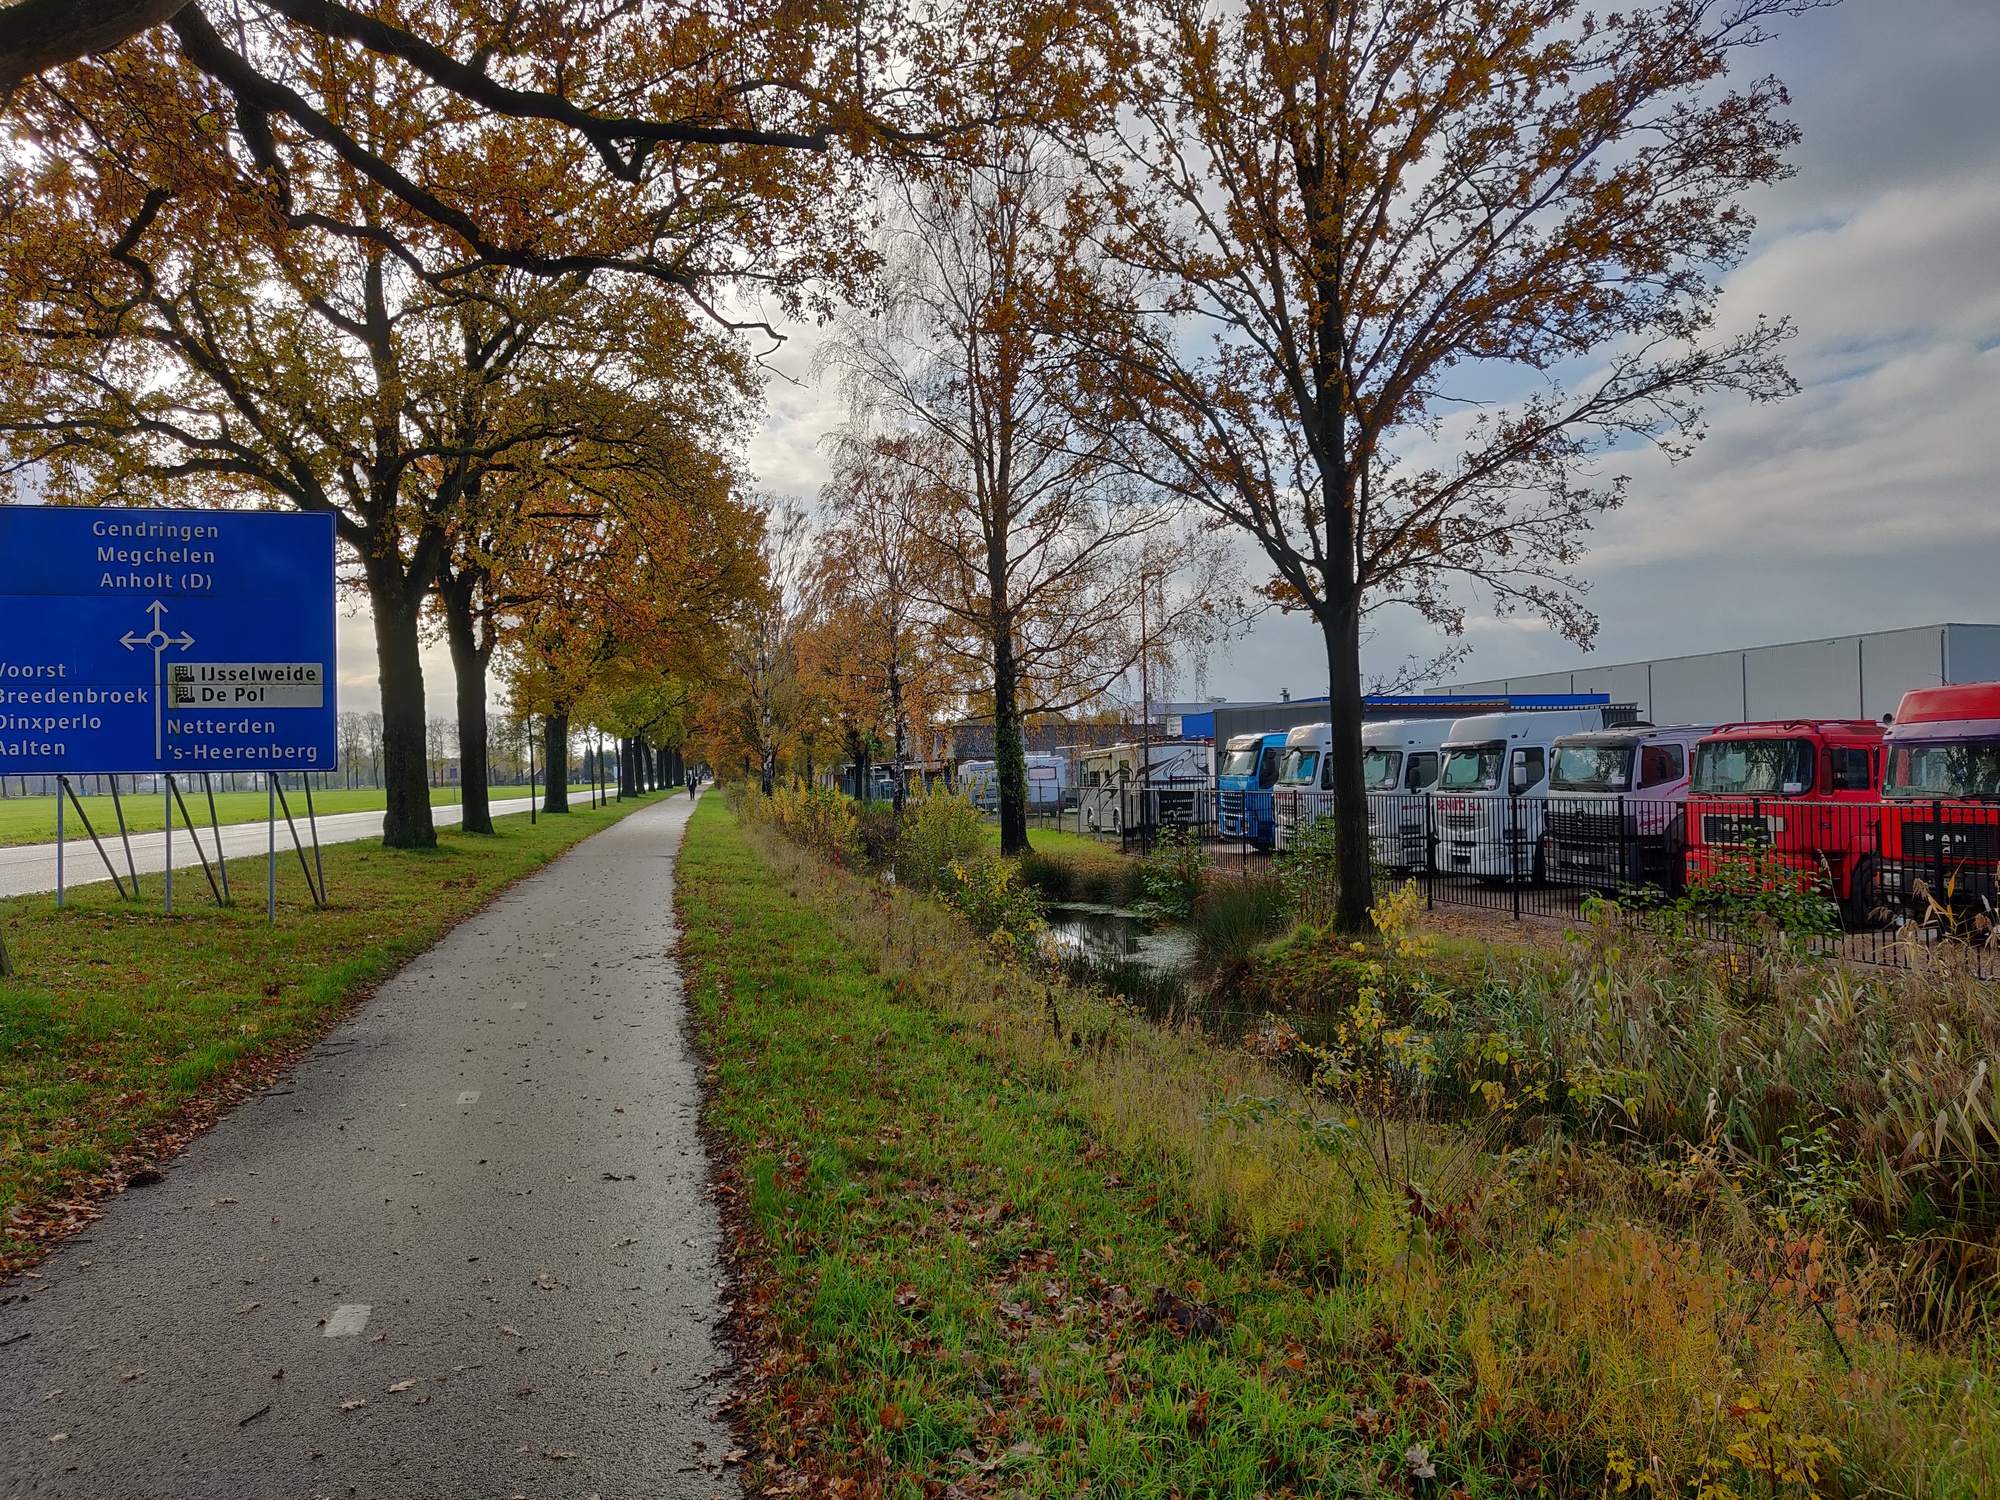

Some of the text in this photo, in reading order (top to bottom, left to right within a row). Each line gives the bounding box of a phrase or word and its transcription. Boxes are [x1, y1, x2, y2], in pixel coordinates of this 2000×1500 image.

[92, 521, 218, 542] Gendringen
[97, 546, 215, 566] Megchelen
[100, 572, 212, 590] Anholt (D)
[201, 665, 316, 681] IJsselweide
[202, 687, 265, 702] De Pol
[0, 713, 102, 734] Dinxperlo
[167, 719, 275, 734] Netterden
[167, 743, 318, 762] 's-Heerenberg
[1720, 823, 1752, 832] MAN
[1925, 833, 1967, 843] MAN
